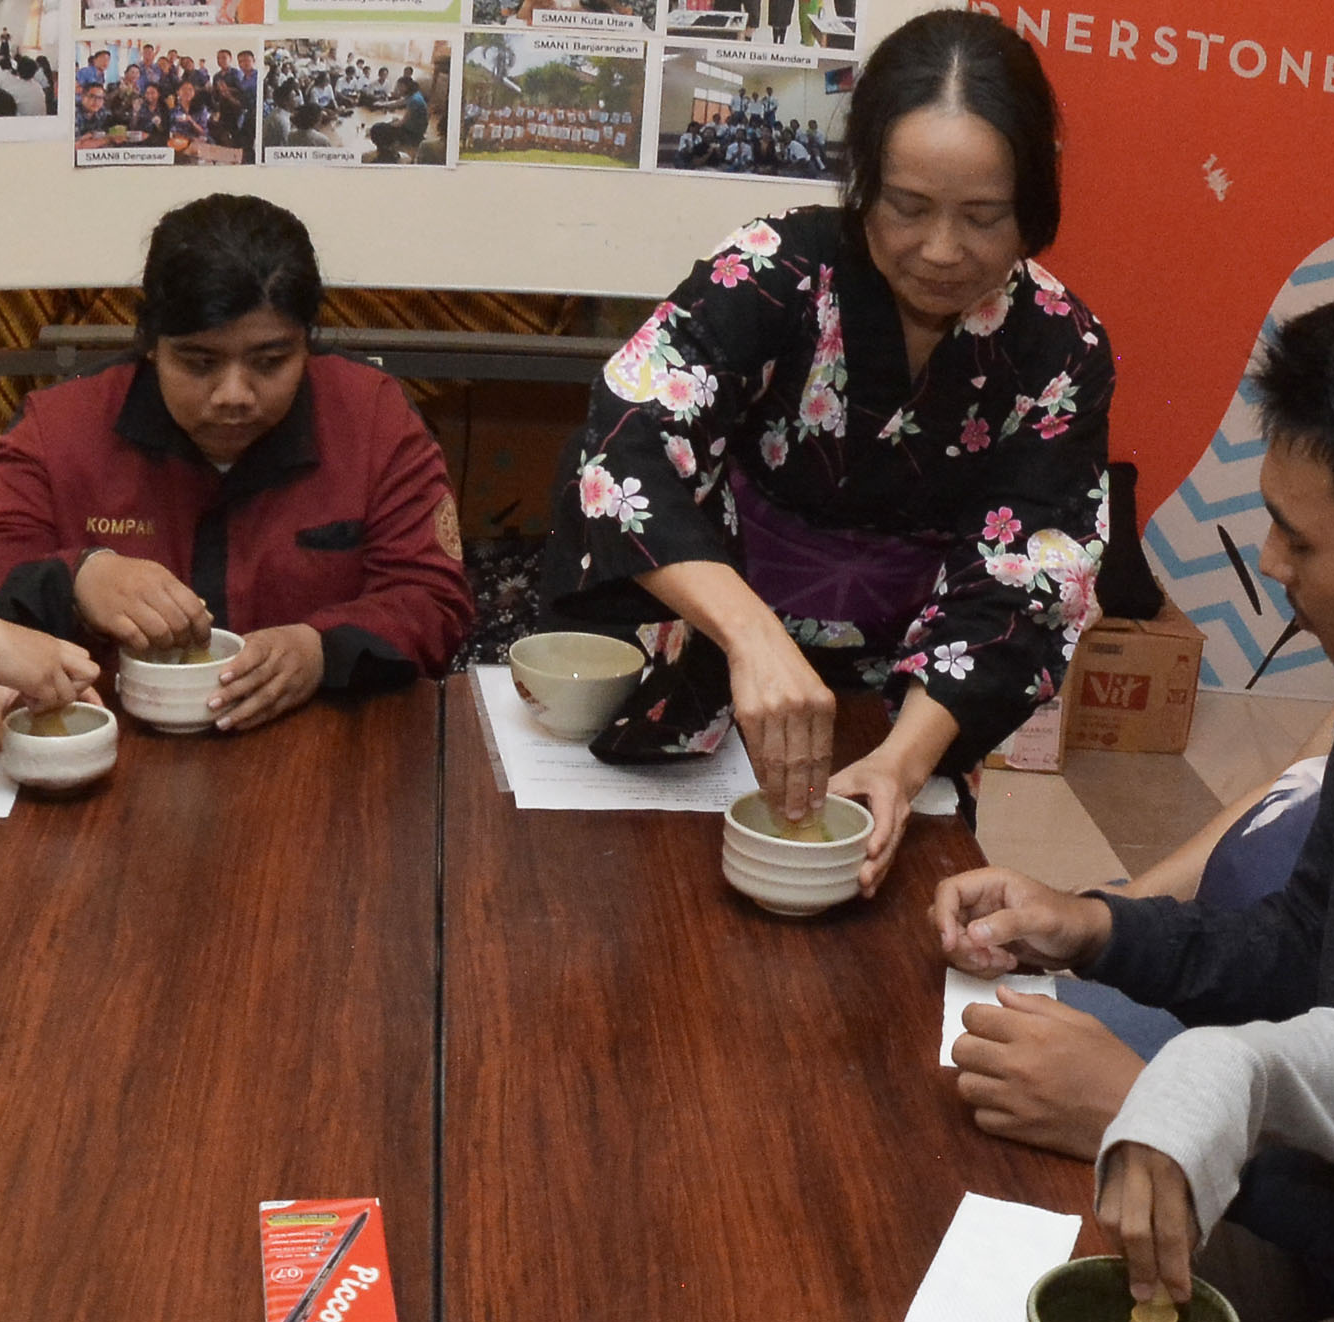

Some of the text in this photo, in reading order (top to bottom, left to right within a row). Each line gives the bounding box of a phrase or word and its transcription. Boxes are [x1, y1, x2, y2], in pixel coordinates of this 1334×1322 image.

[93, 10, 210, 21] SMK Pariwisata Harapan
[541, 13, 635, 28] SMAN1 Kuta Utara
[533, 40, 639, 54] SMAN1 Banjarangkan
[715, 49, 812, 64] SMAN Bali Mandara
[122, 151, 168, 163] Denpasar
[311, 151, 356, 163] Singaraja
